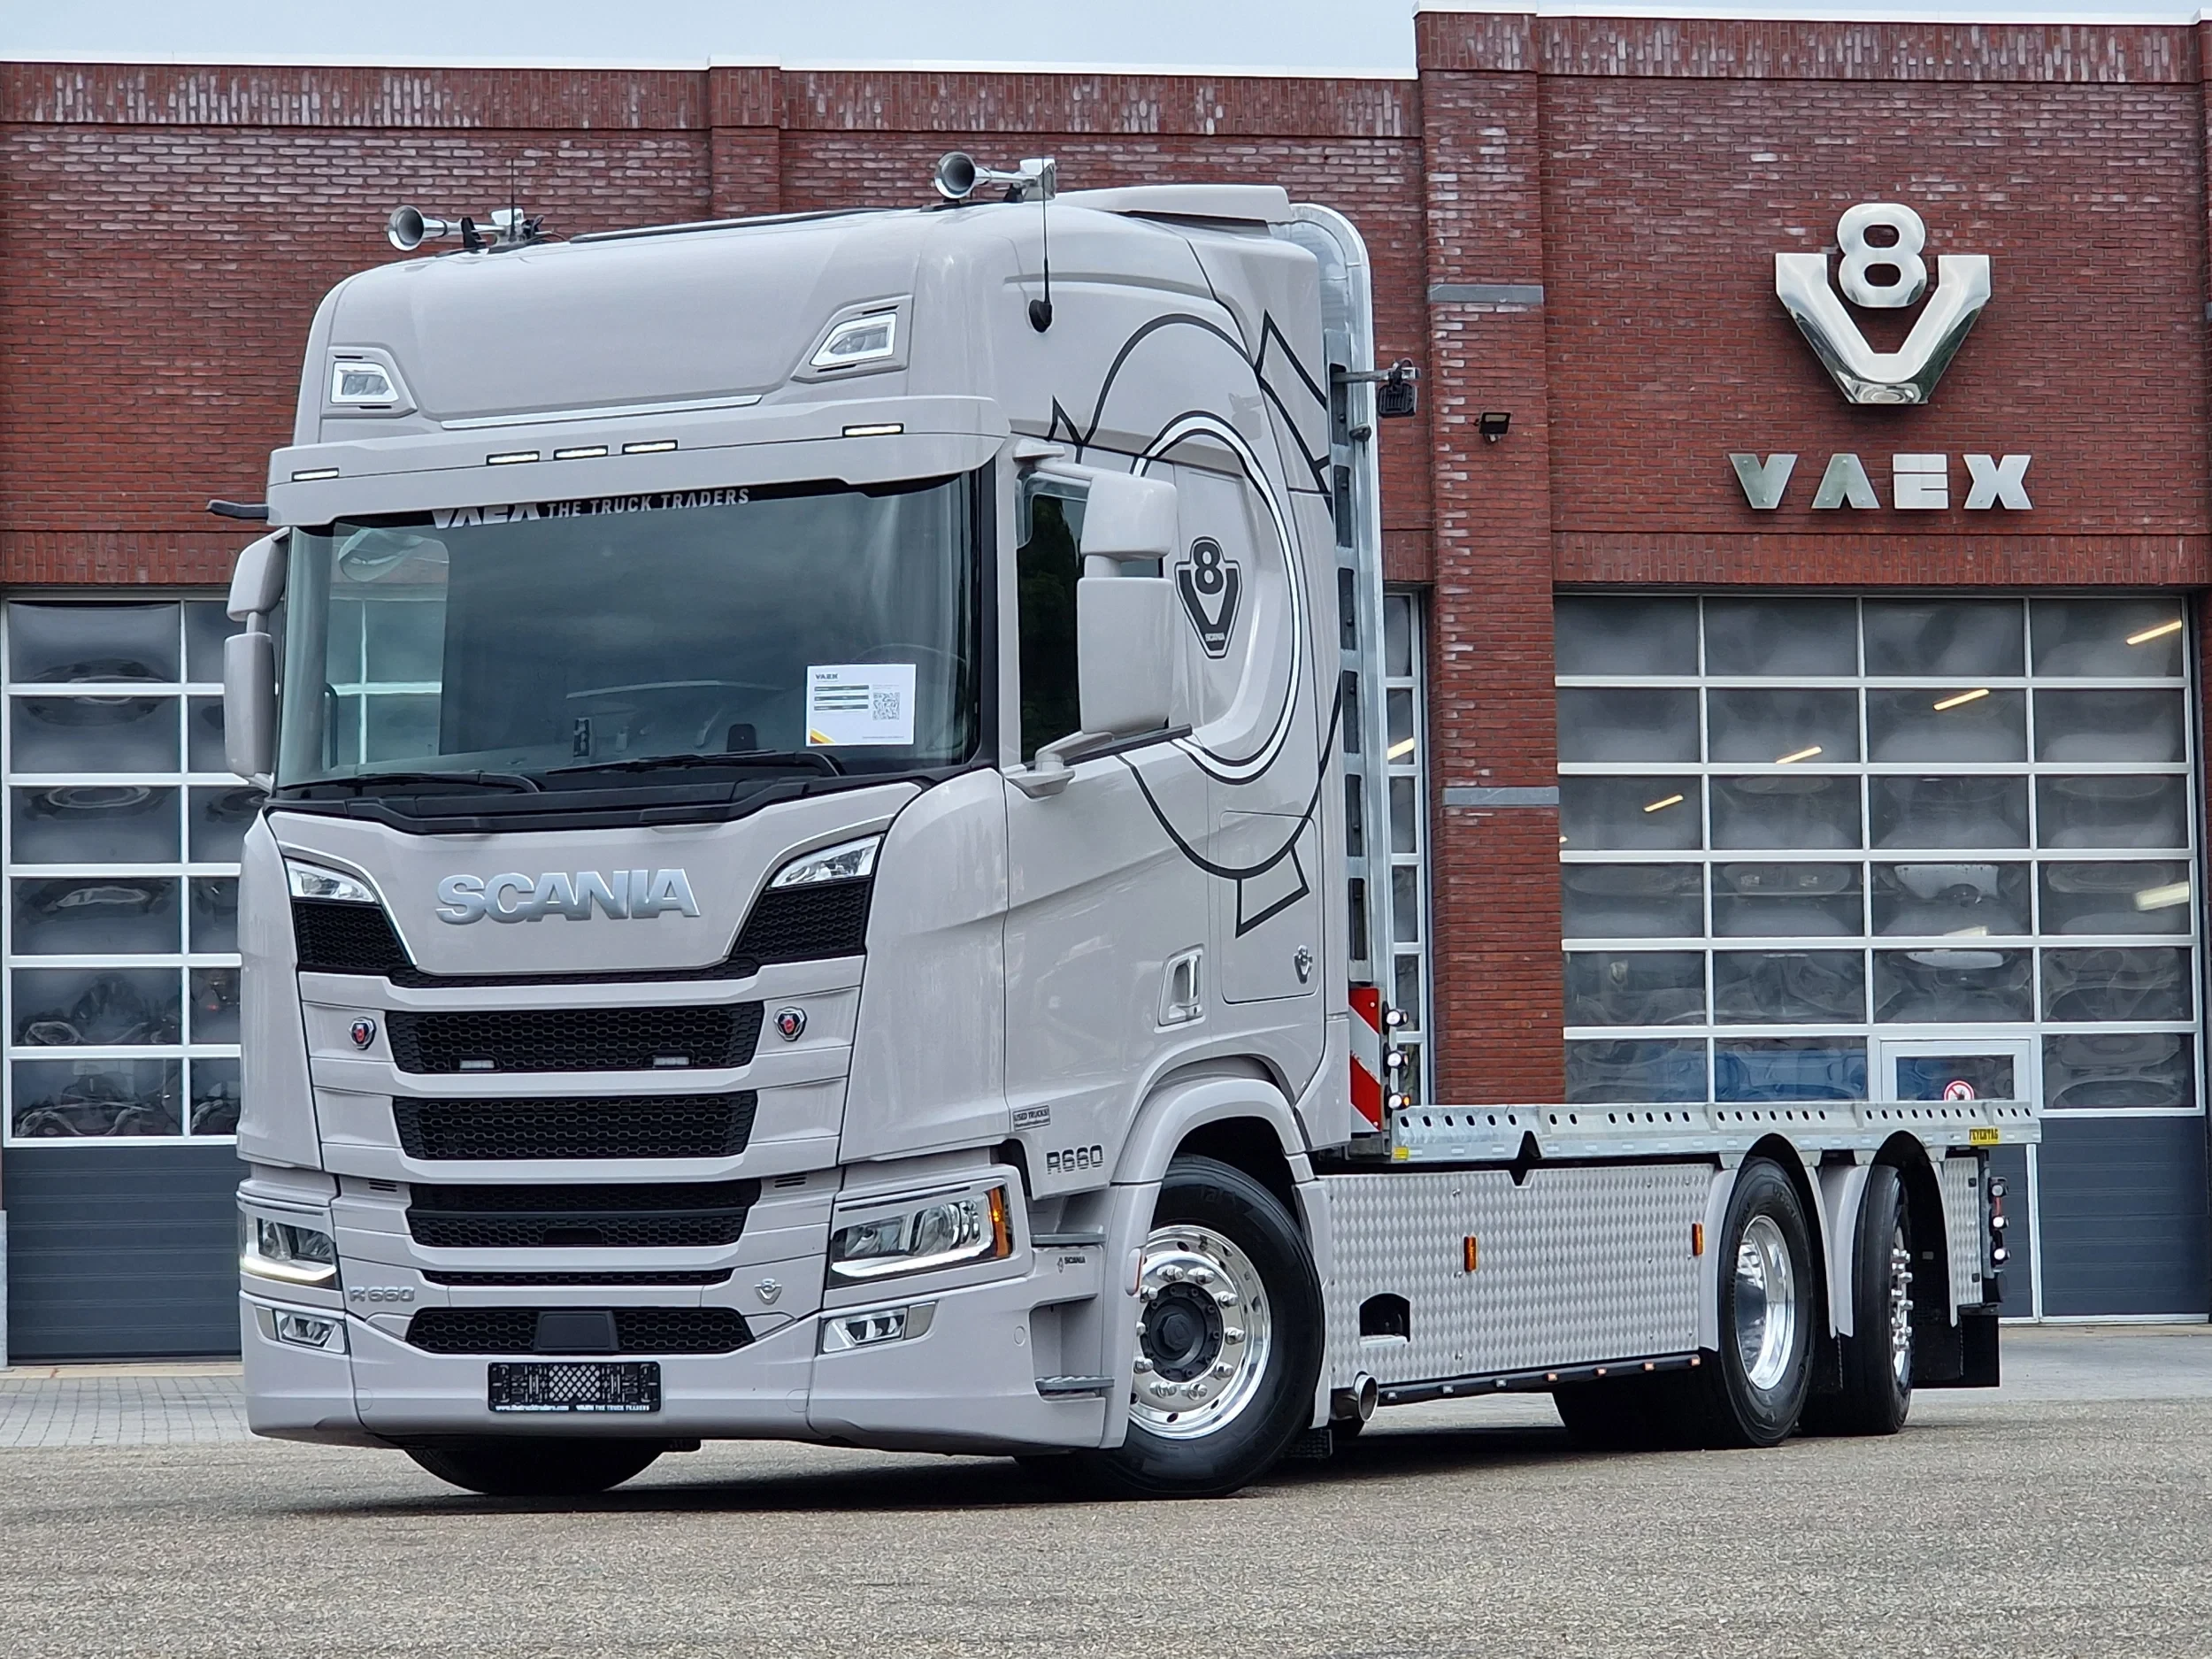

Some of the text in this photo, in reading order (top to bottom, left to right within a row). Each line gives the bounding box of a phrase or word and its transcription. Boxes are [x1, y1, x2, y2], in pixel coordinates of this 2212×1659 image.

[1728, 453, 2033, 510] VAEX
[547, 501, 581, 519] THE
[590, 495, 652, 516] TRUCK
[661, 488, 750, 510] TRADERS
[435, 868, 701, 926] SCANIA
[1046, 1145, 1103, 1175] R660
[349, 1286, 415, 1302] R660
